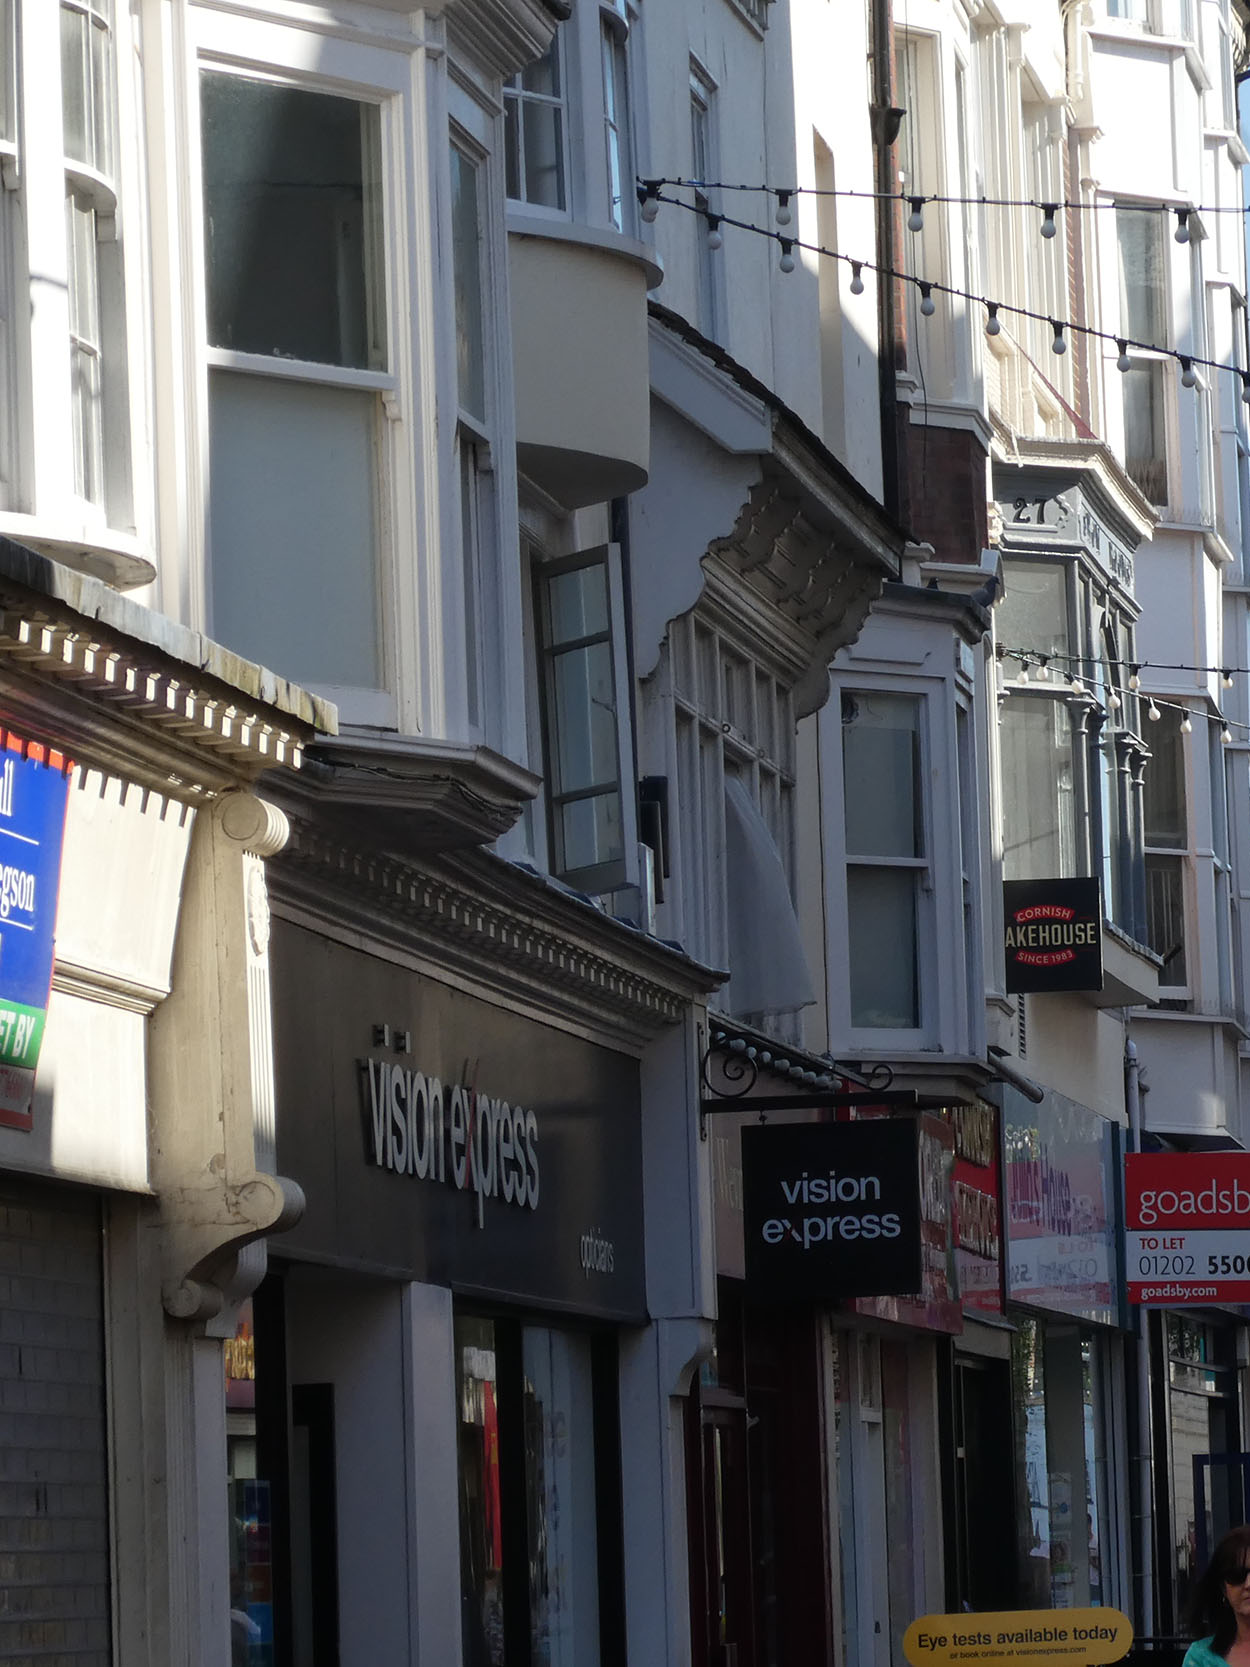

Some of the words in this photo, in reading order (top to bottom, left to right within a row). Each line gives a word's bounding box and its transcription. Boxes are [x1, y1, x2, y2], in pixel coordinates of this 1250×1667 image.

[0, 757, 13, 817] ll
[1016, 907, 1071, 922] CORNISH
[1018, 952, 1049, 964] SINCE
[1051, 950, 1073, 963] 1983
[11, 1014, 36, 1060] BY
[367, 1026, 445, 1183] vision
[450, 1060, 540, 1229] express
[779, 1170, 881, 1204] vision
[762, 1212, 901, 1250] express
[1139, 1237, 1159, 1250] TO
[1162, 1237, 1185, 1250] LET
[580, 1227, 615, 1279] opticians
[1138, 1255, 1196, 1276] 01202
[1140, 1284, 1217, 1300] goadsby.com
[918, 1633, 948, 1651] Eye
[952, 1632, 992, 1646] tests
[997, 1626, 1068, 1644] available
[1073, 1625, 1118, 1643] today
[959, 1650, 979, 1659] book
[982, 1649, 1005, 1658] online
[1016, 1646, 1087, 1657] visionexpress.com
